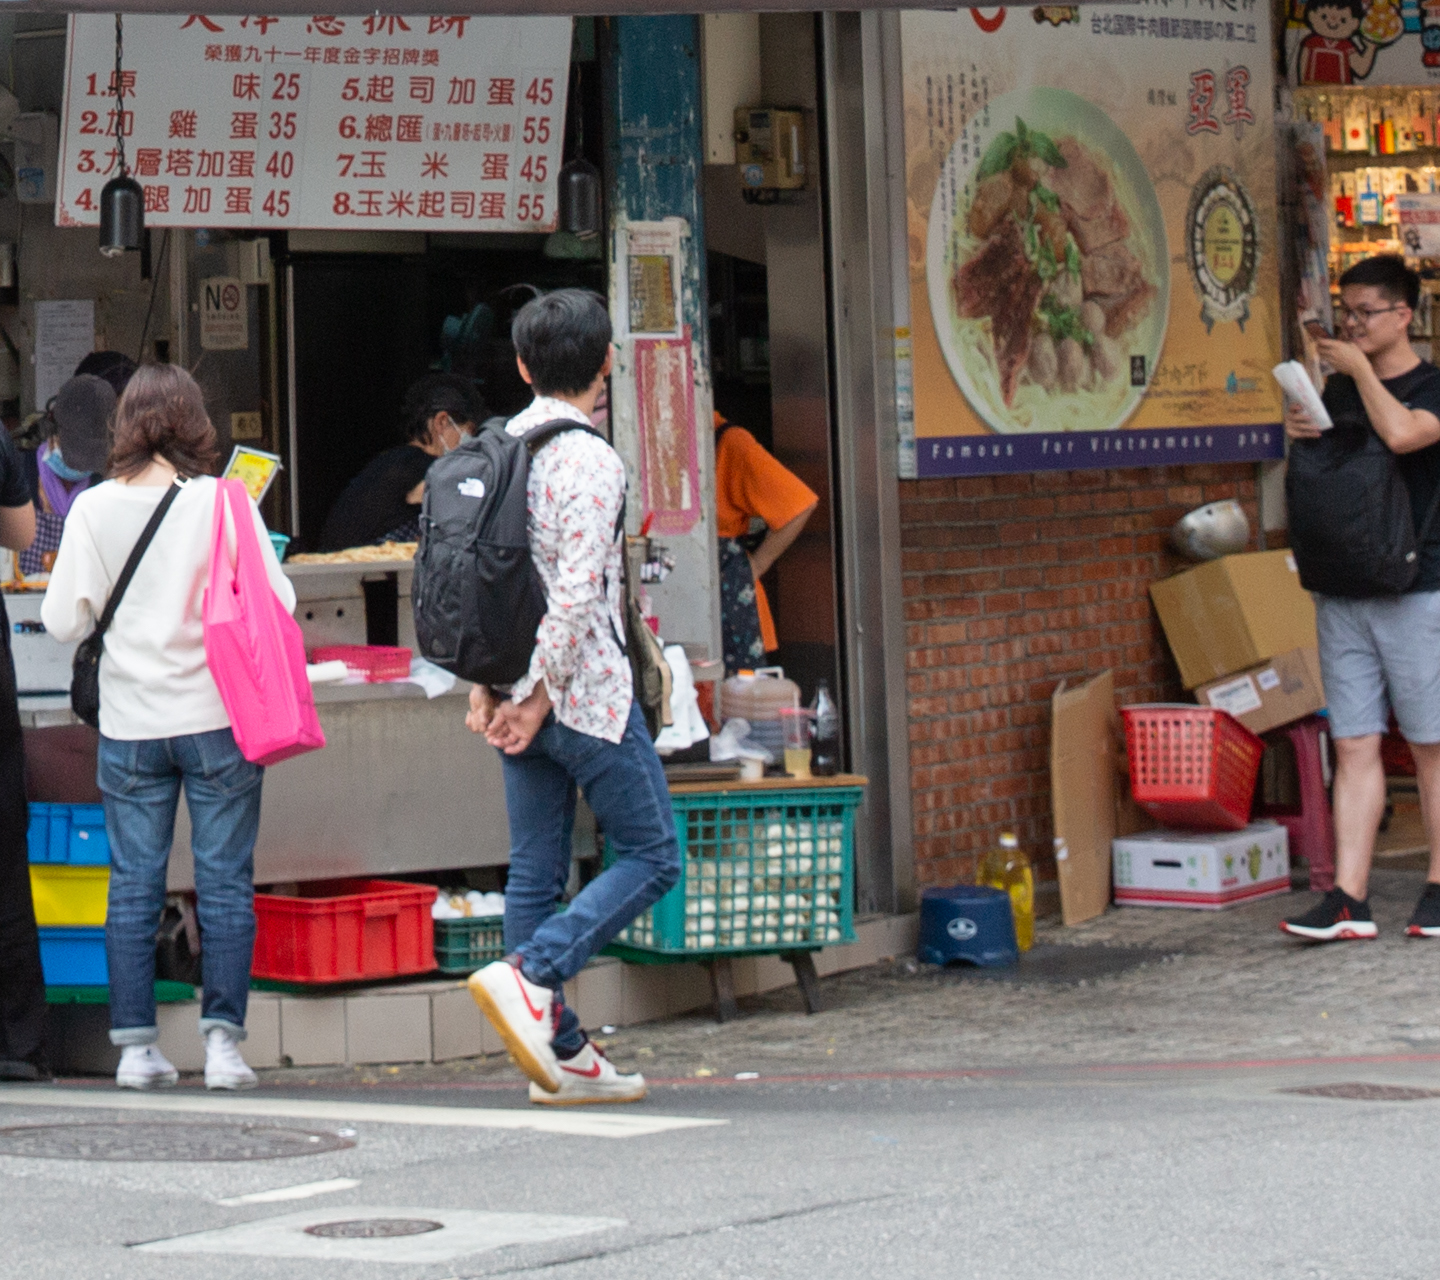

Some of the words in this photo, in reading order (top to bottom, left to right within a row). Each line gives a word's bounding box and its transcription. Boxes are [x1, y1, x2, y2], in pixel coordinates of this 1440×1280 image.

[204, 44, 440, 67] 榮獲九十一年度金字招牌獎
[271, 72, 302, 101] 25
[525, 77, 554, 106] 45
[268, 111, 297, 140] 35
[522, 116, 551, 144] 55
[265, 150, 294, 179] 40
[520, 154, 548, 183] 45
[74, 185, 253, 215] 4.腿加蛋
[262, 190, 291, 218] 45
[516, 194, 545, 222] 55
[931, 442, 1016, 460] Famous
[1041, 439, 1075, 455] for
[1089, 434, 1215, 454] Vietnamese
[1237, 431, 1272, 449] pho
